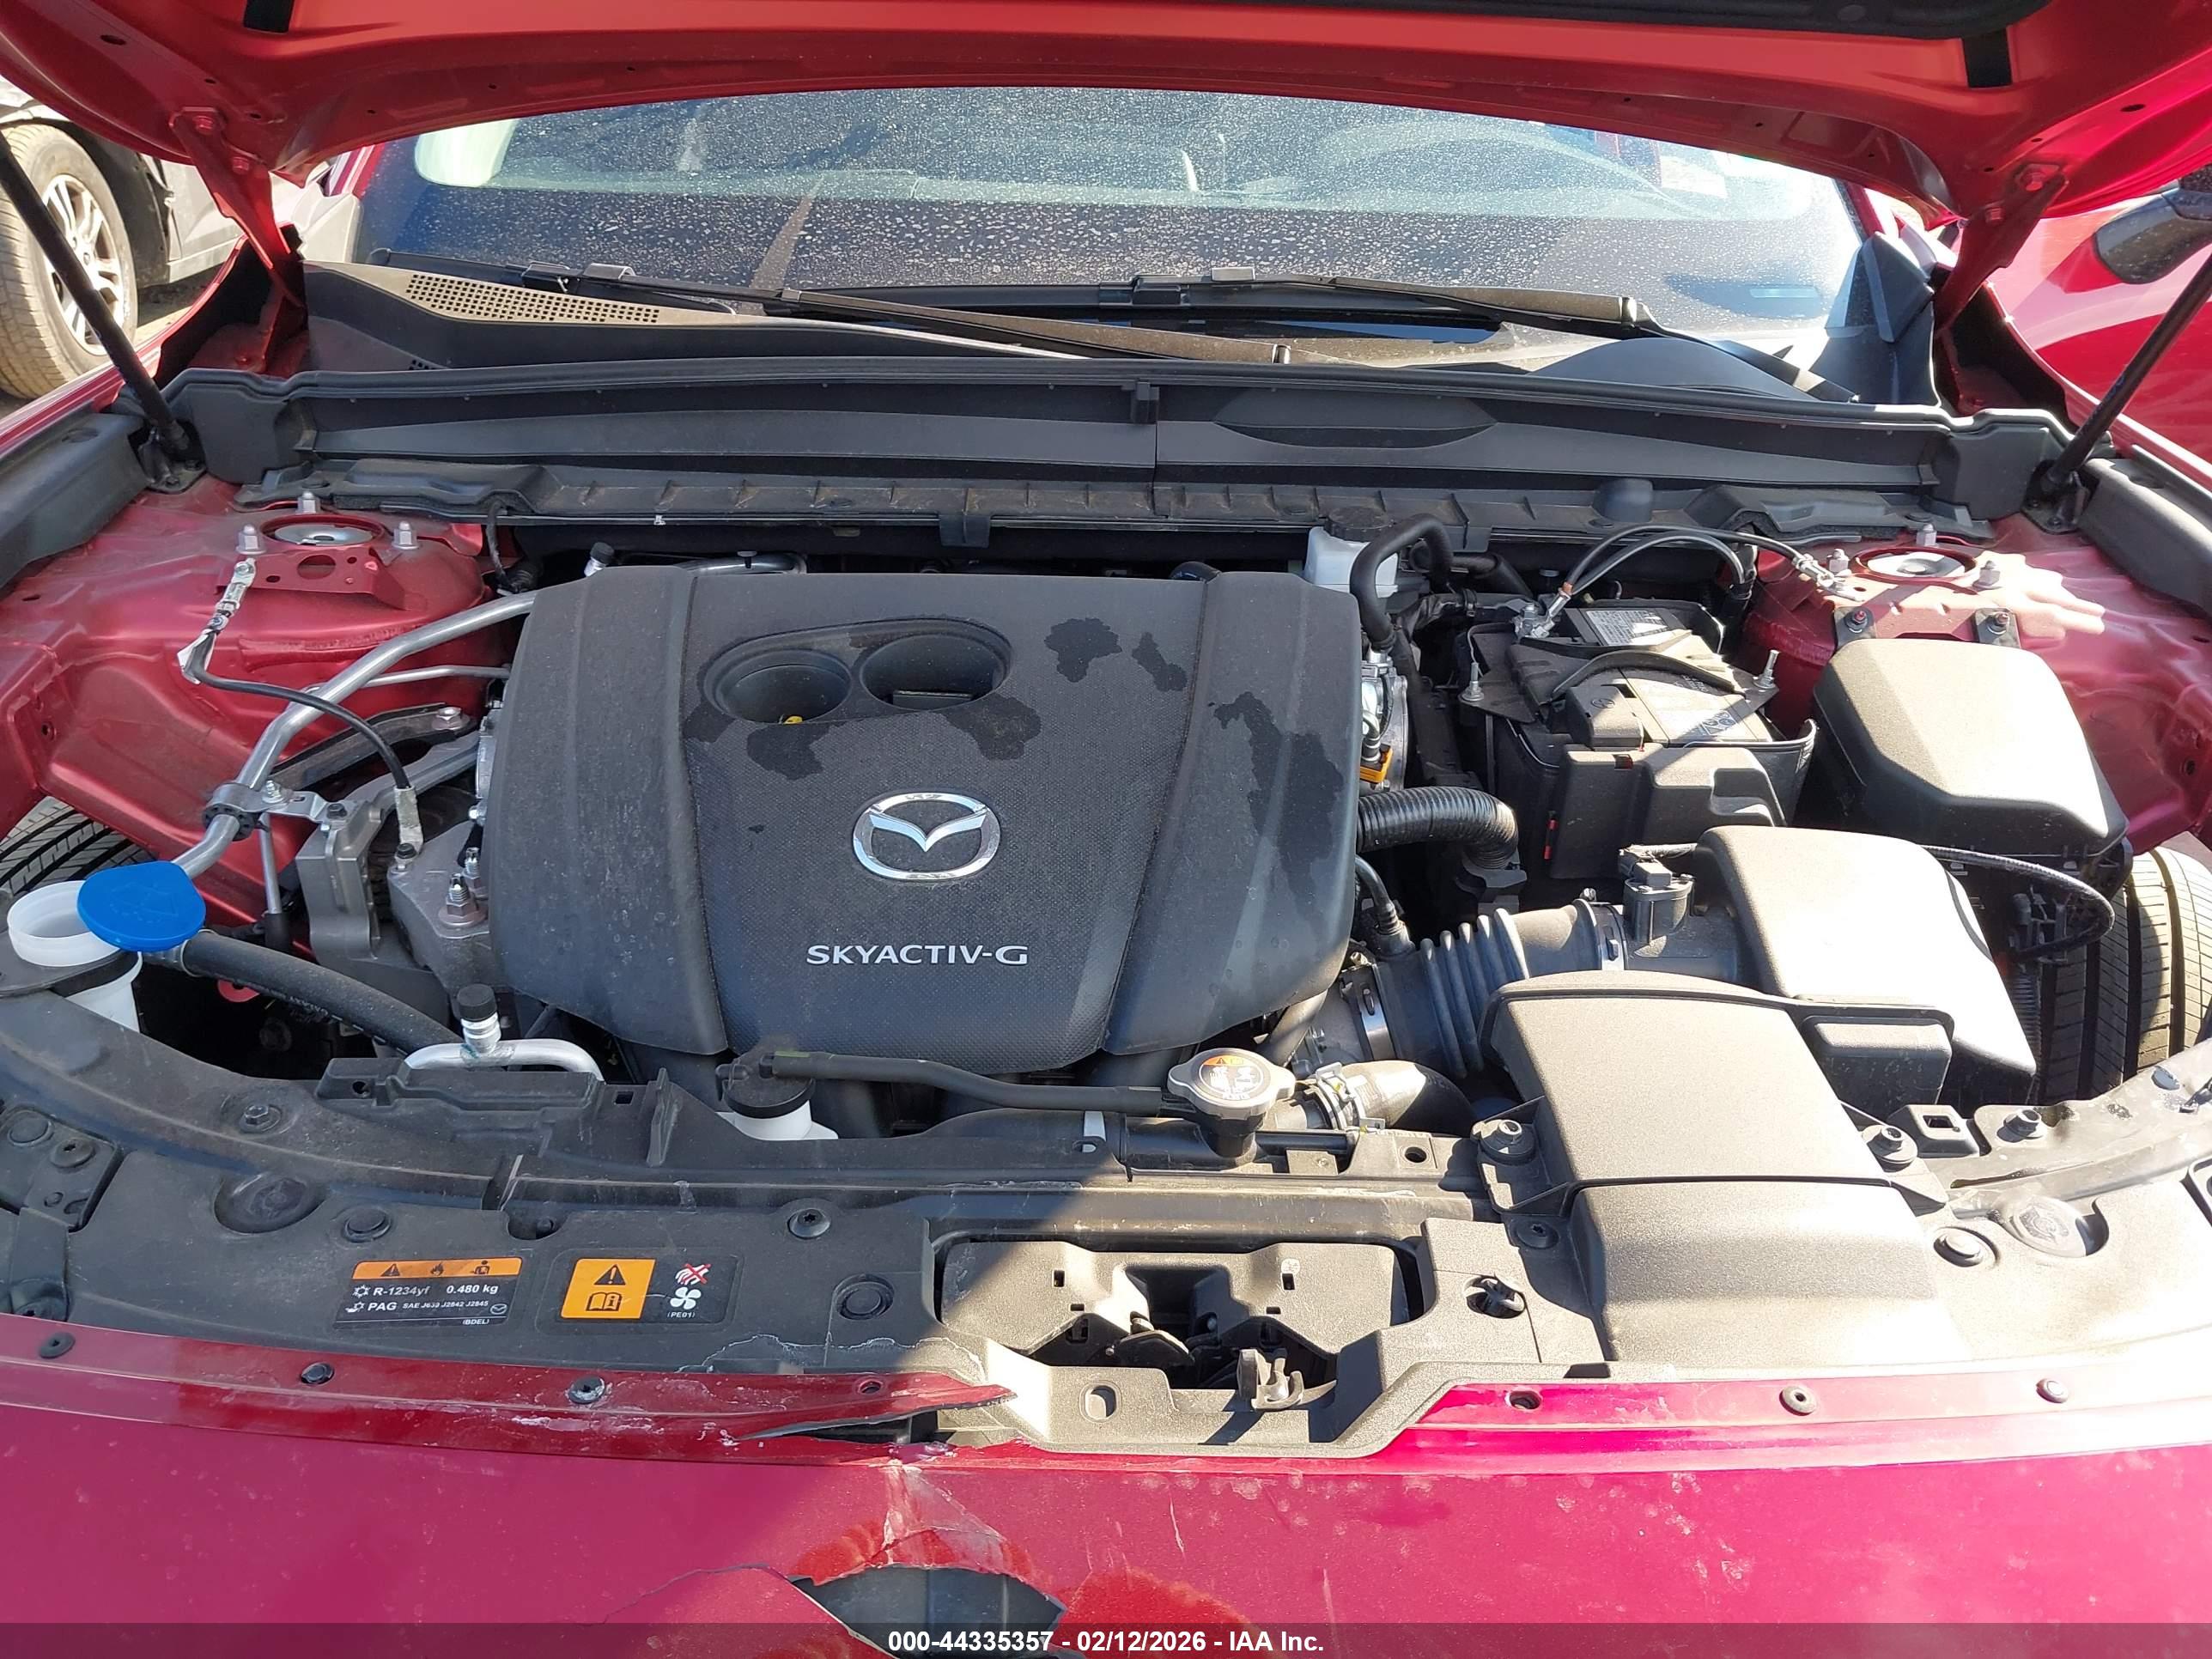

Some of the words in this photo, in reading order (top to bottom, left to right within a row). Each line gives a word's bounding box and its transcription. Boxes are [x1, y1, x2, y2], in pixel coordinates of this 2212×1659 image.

[806, 945, 1029, 965] SKYACTIV-G
[373, 1285, 429, 1297] R-1234yf
[446, 1285, 479, 1295] 0.480
[482, 1284, 499, 1295] kg
[368, 1301, 398, 1312] PAG
